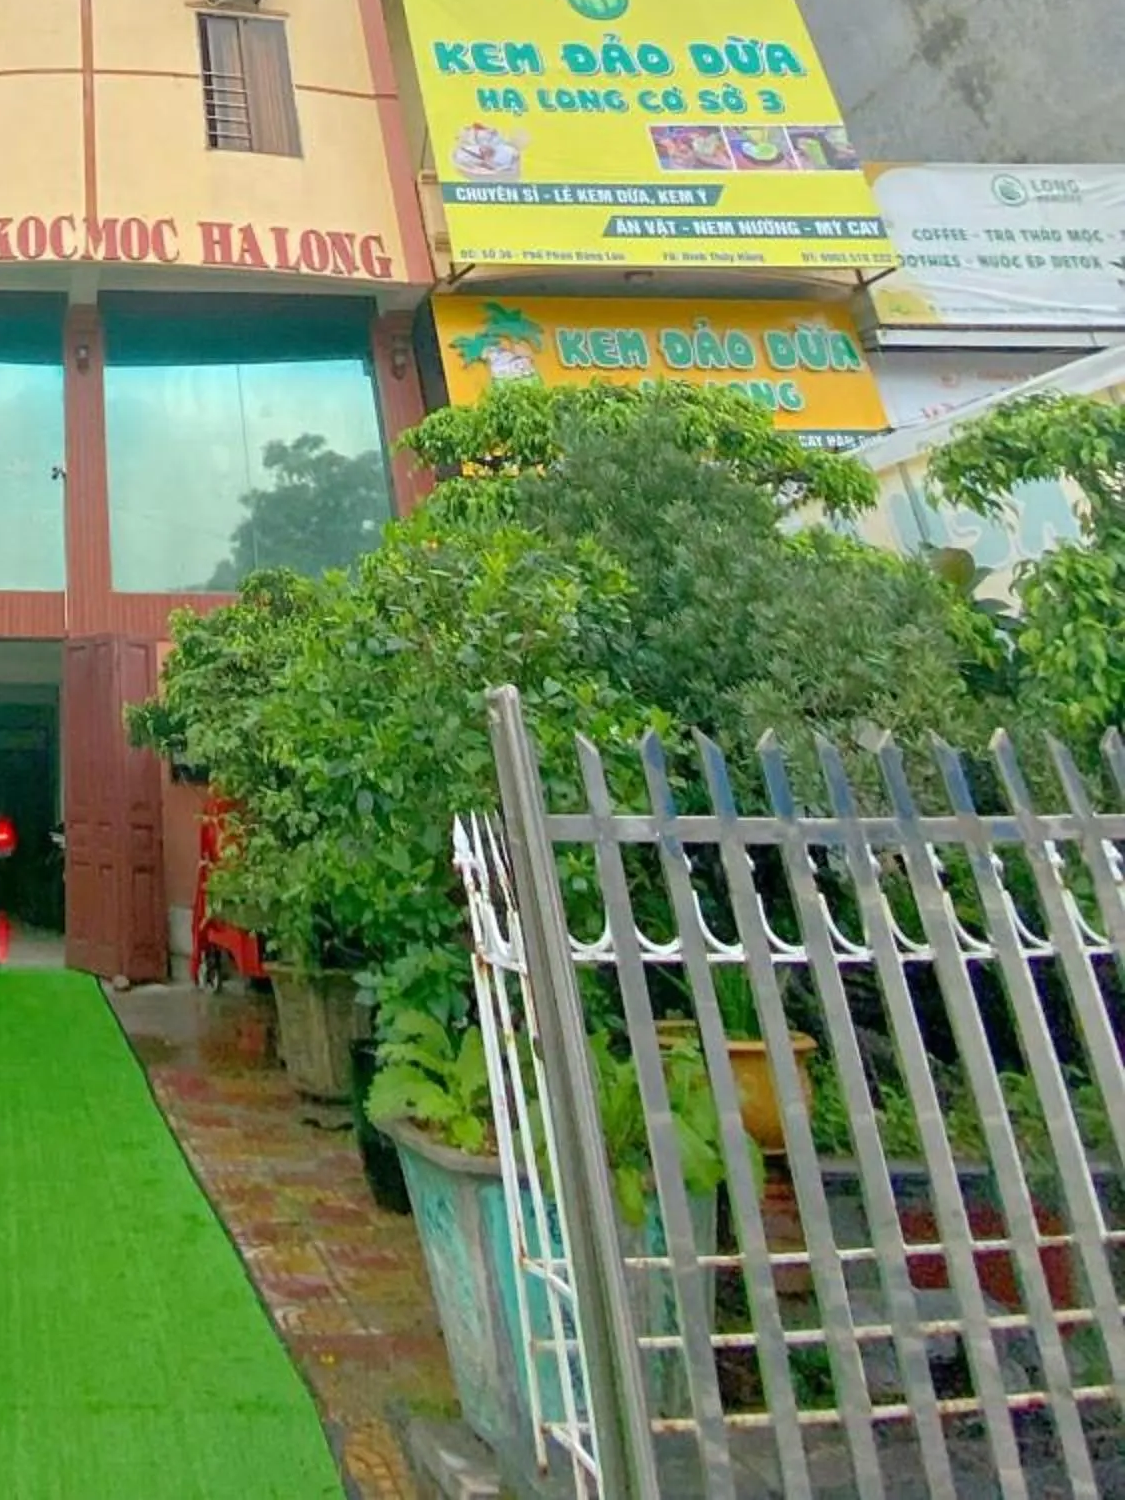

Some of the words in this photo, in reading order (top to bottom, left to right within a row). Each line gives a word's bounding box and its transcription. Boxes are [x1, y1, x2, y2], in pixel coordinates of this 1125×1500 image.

[432, 40, 544, 76] KEM
[561, 33, 675, 77] ĐẢO
[687, 35, 807, 78] DỪA
[476, 87, 528, 117] HẠ
[536, 87, 629, 114] LONG
[757, 88, 787, 115] 3
[455, 185, 519, 202] CHUYÊN
[576, 189, 612, 203] KEM
[659, 189, 692, 205] KEM
[692, 219, 736, 236] NEM
[847, 219, 881, 237] CAY
[912, 228, 968, 241] COFFEE
[555, 328, 650, 369] KEM
[764, 323, 864, 371] DỪA
[707, 379, 805, 411] NG
